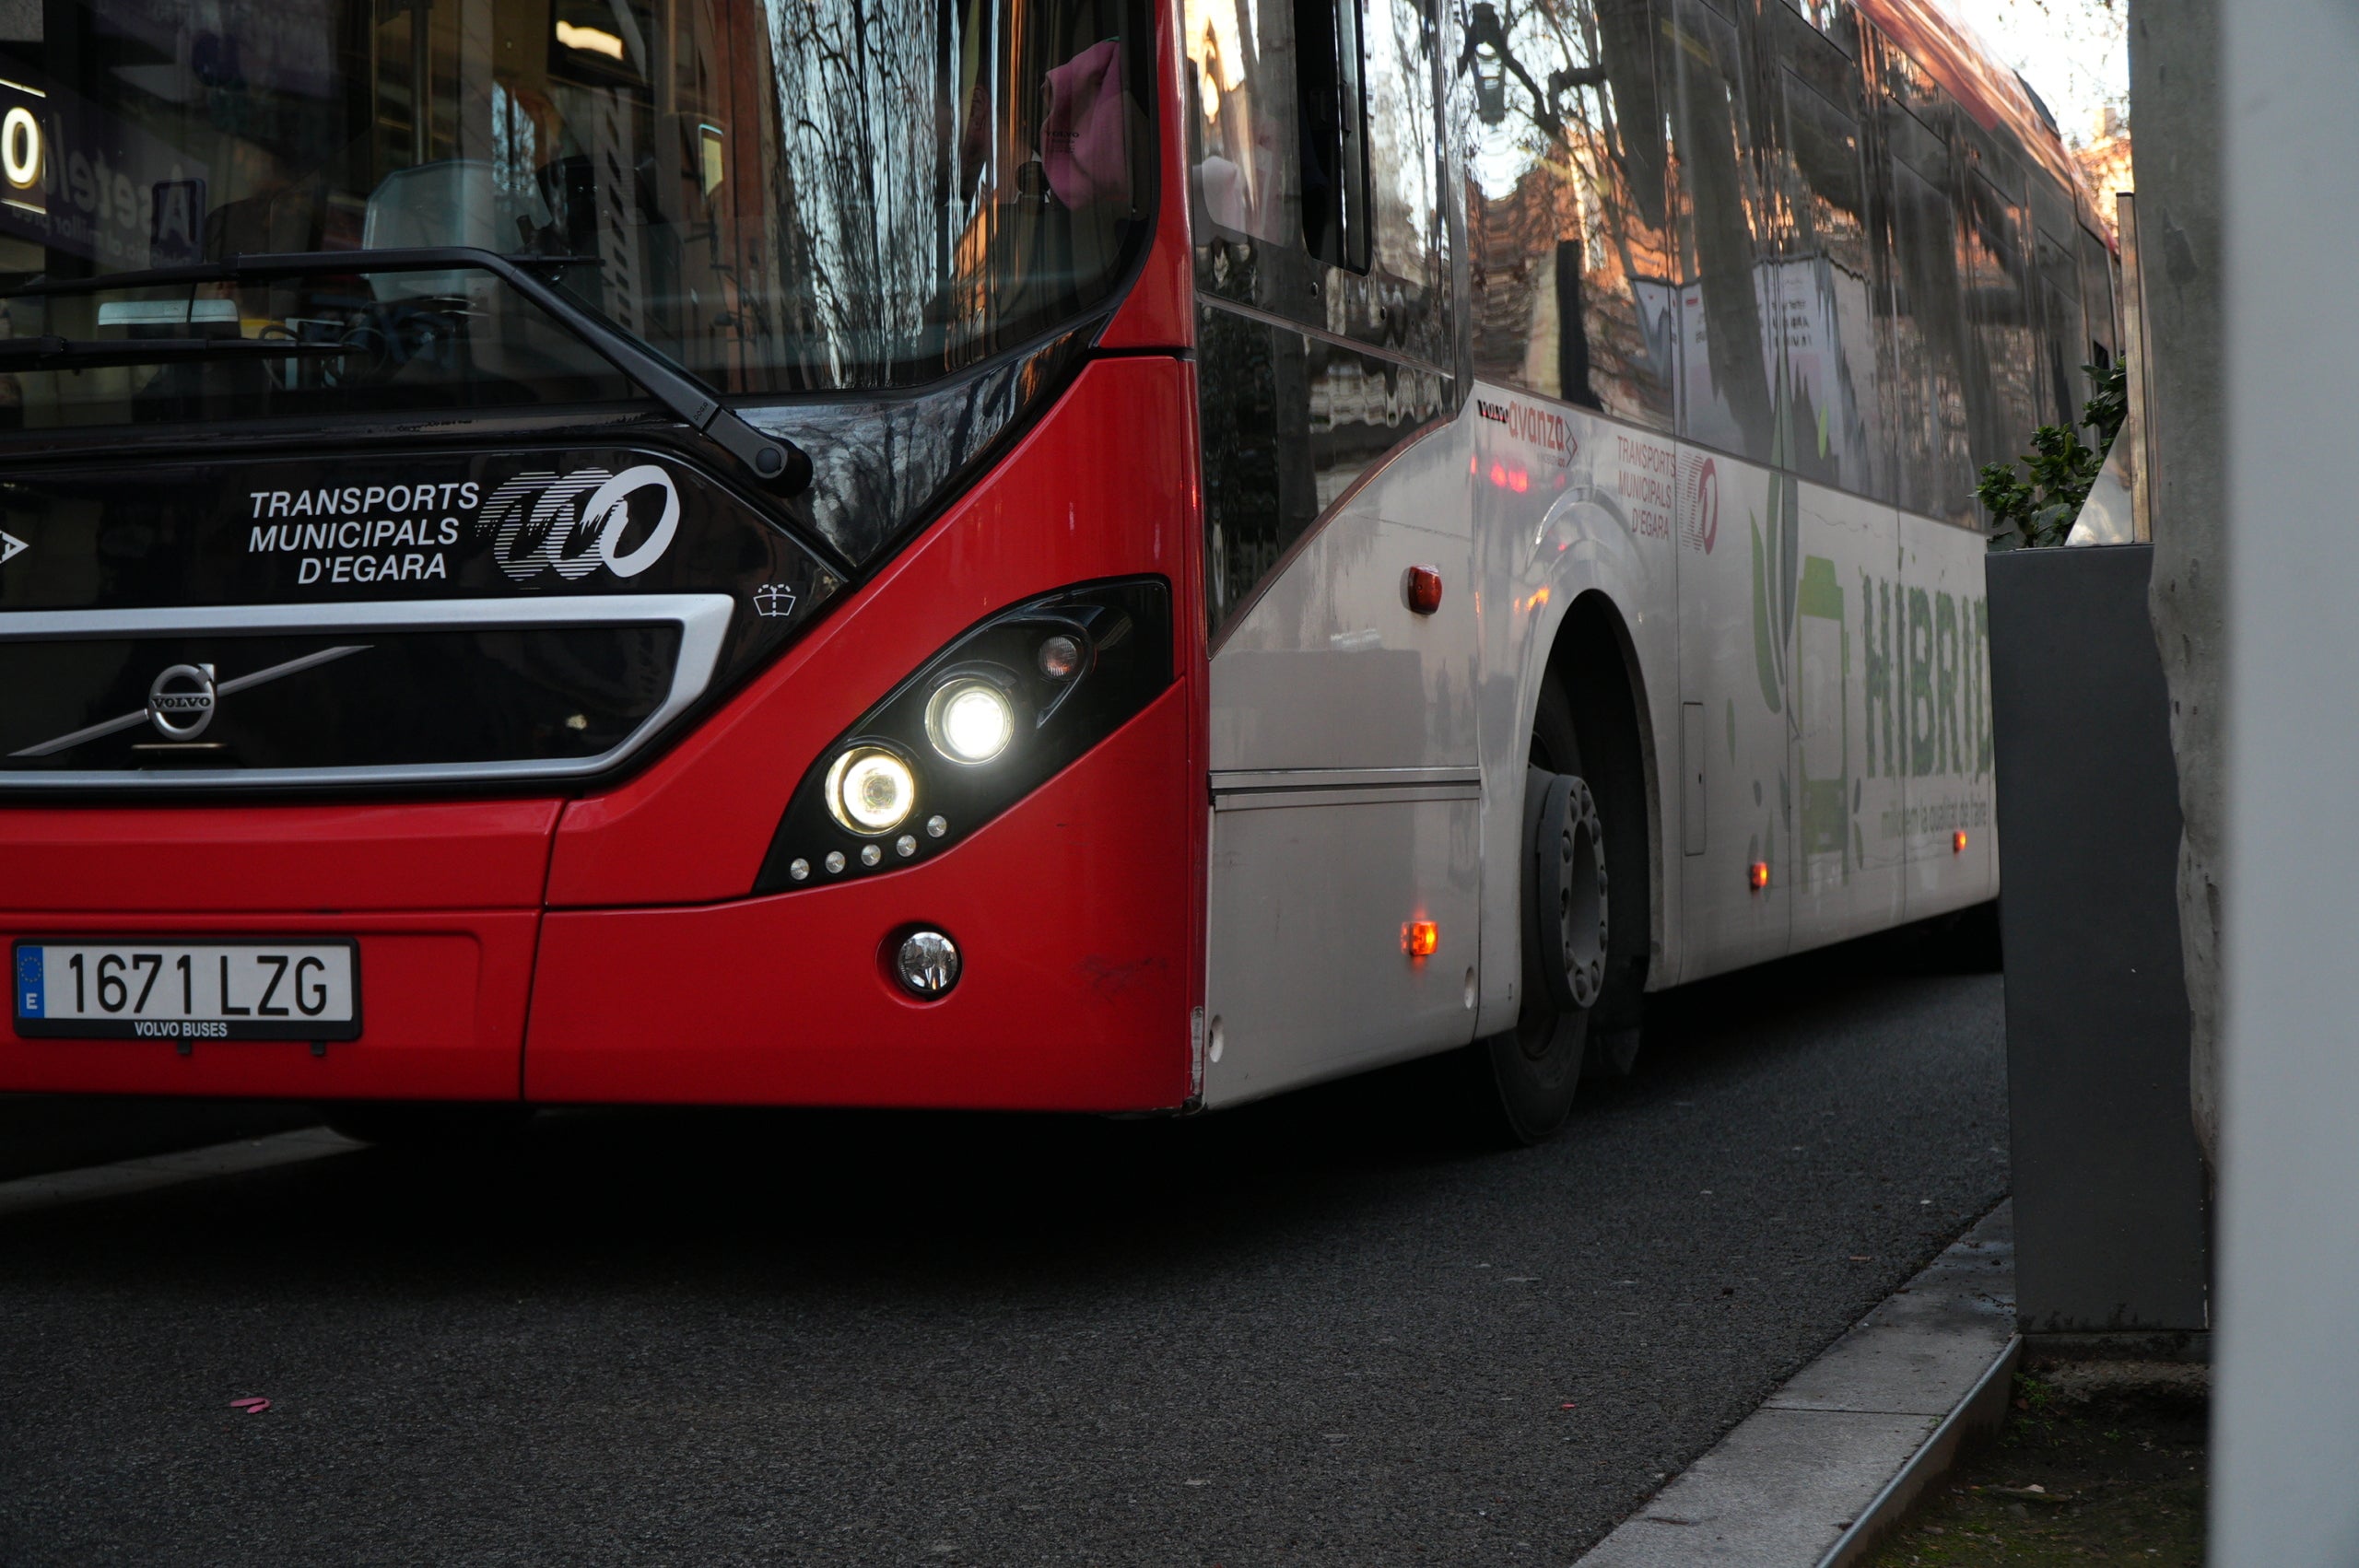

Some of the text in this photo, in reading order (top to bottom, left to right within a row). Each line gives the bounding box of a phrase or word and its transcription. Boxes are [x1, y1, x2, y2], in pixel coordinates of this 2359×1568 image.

[1508, 401, 1565, 451] avanza
[1617, 435, 1675, 478] TRANSPORTS
[249, 482, 480, 519] TRANSPORTS
[1618, 470, 1672, 509] MUNICIPALS
[248, 517, 460, 553] MUNICIPALS
[1632, 507, 1670, 542] D'EGARA
[298, 553, 447, 584] D'EGARA
[152, 696, 211, 708] VOLVO
[26, 993, 38, 1010] E
[69, 953, 327, 1016] 1671 LZG
[135, 1022, 228, 1037] VOLVO BUSES
